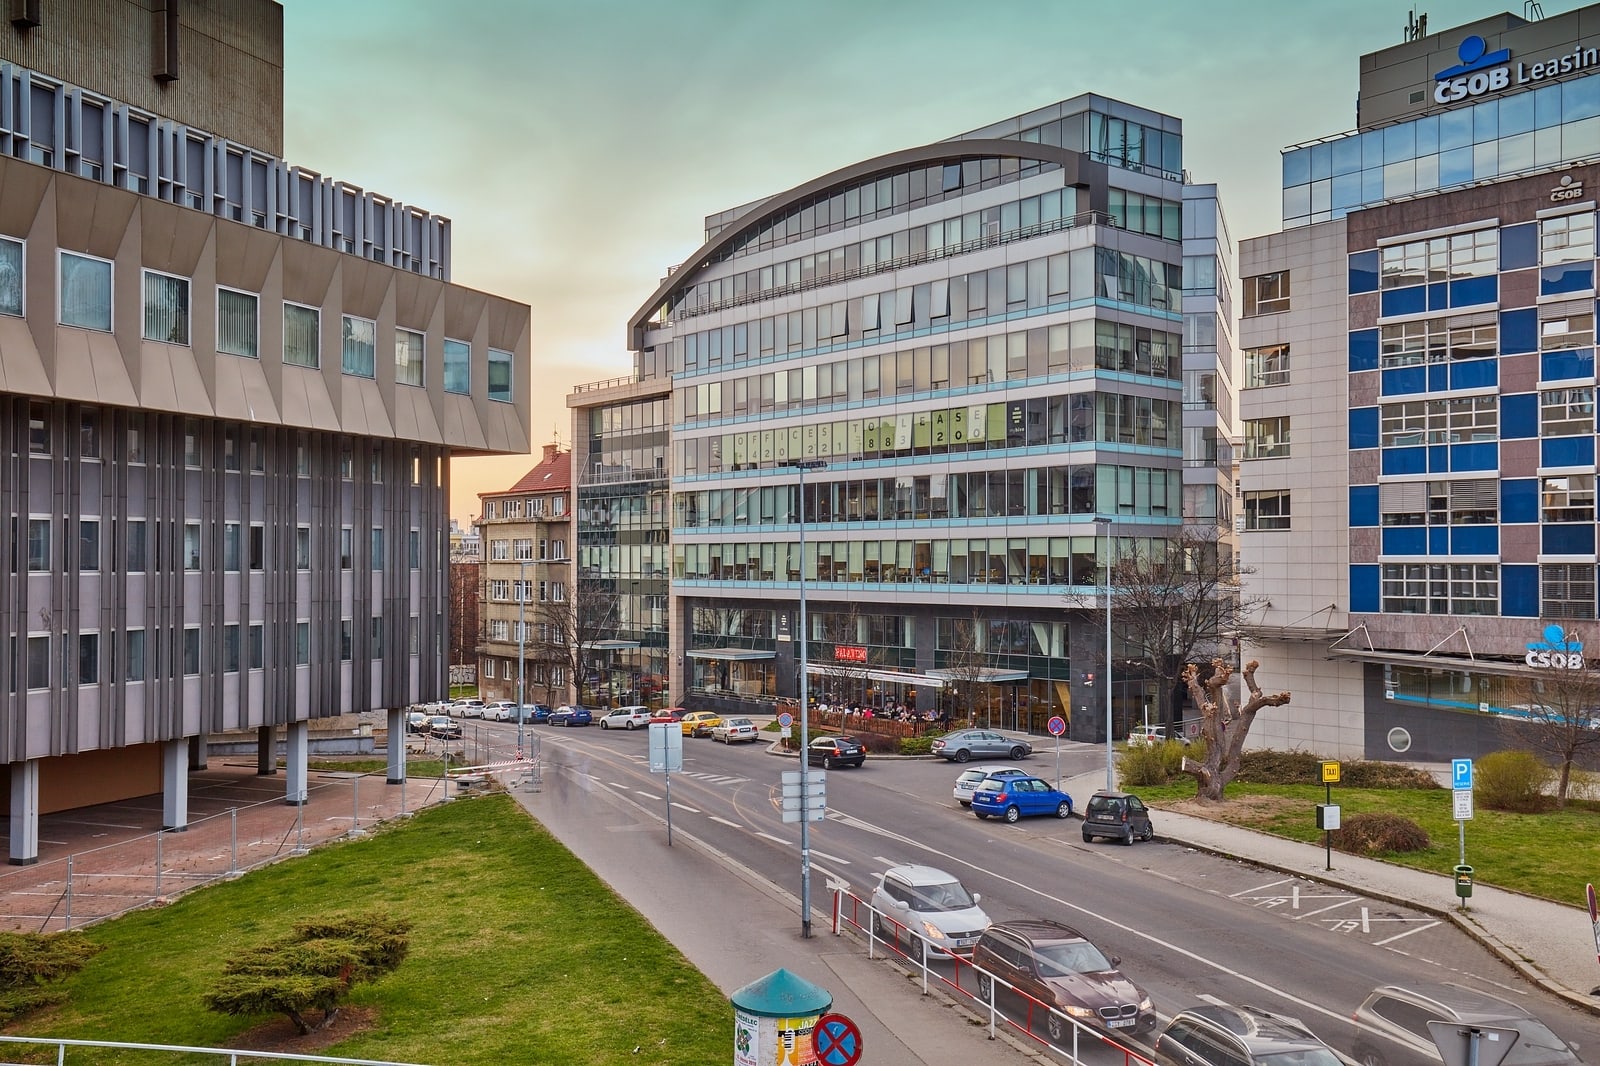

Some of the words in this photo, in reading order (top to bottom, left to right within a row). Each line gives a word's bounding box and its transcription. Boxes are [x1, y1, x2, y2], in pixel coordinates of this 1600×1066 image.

[1434, 67, 1510, 104] ČSOB
[1517, 45, 1600, 83] Leasin
[1551, 188, 1583, 202] ČSOB
[738, 427, 828, 446] OFFICES
[853, 422, 875, 433] TO
[902, 409, 980, 428] LEASE
[1525, 648, 1583, 669] ČSOB
[1326, 768, 1337, 776] TAXI
[1456, 763, 1468, 781] P
